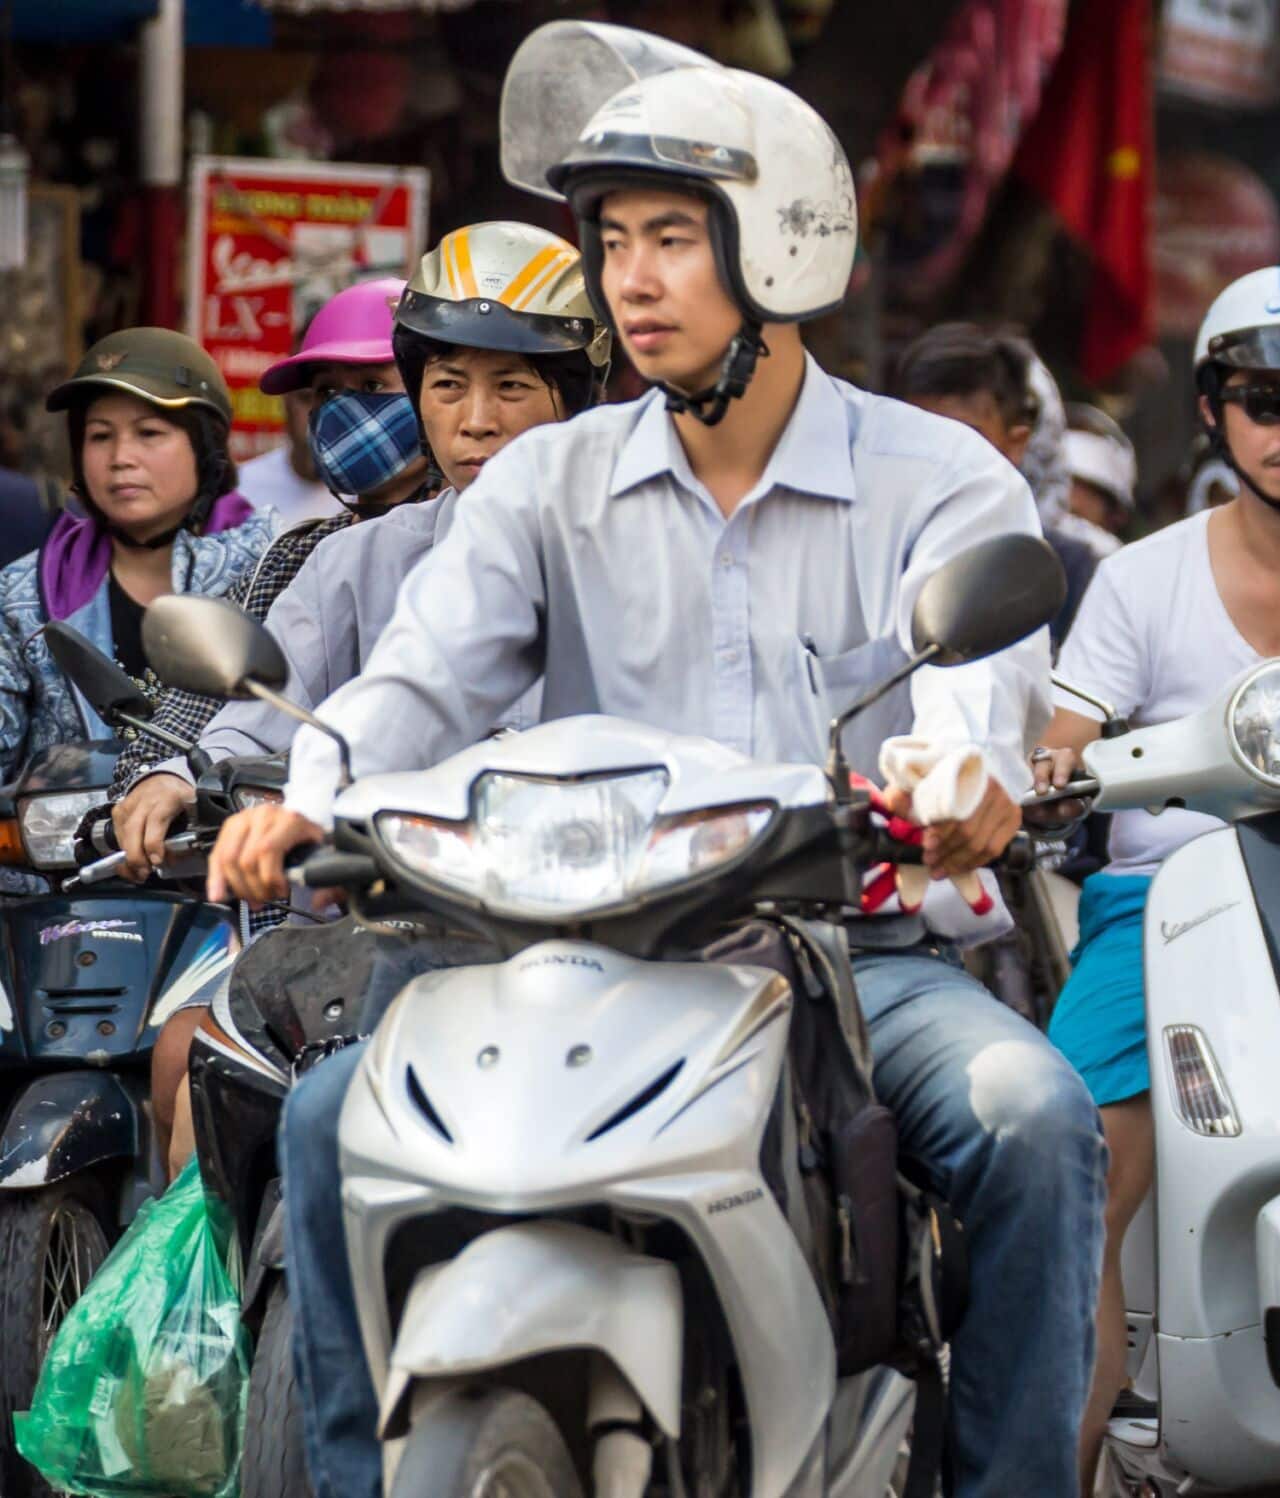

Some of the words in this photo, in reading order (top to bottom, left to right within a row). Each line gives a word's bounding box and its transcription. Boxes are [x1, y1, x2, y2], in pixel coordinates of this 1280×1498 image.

[91, 930, 143, 942] HONDA
[519, 953, 605, 973] HONDA
[707, 1187, 764, 1214] HONDA
